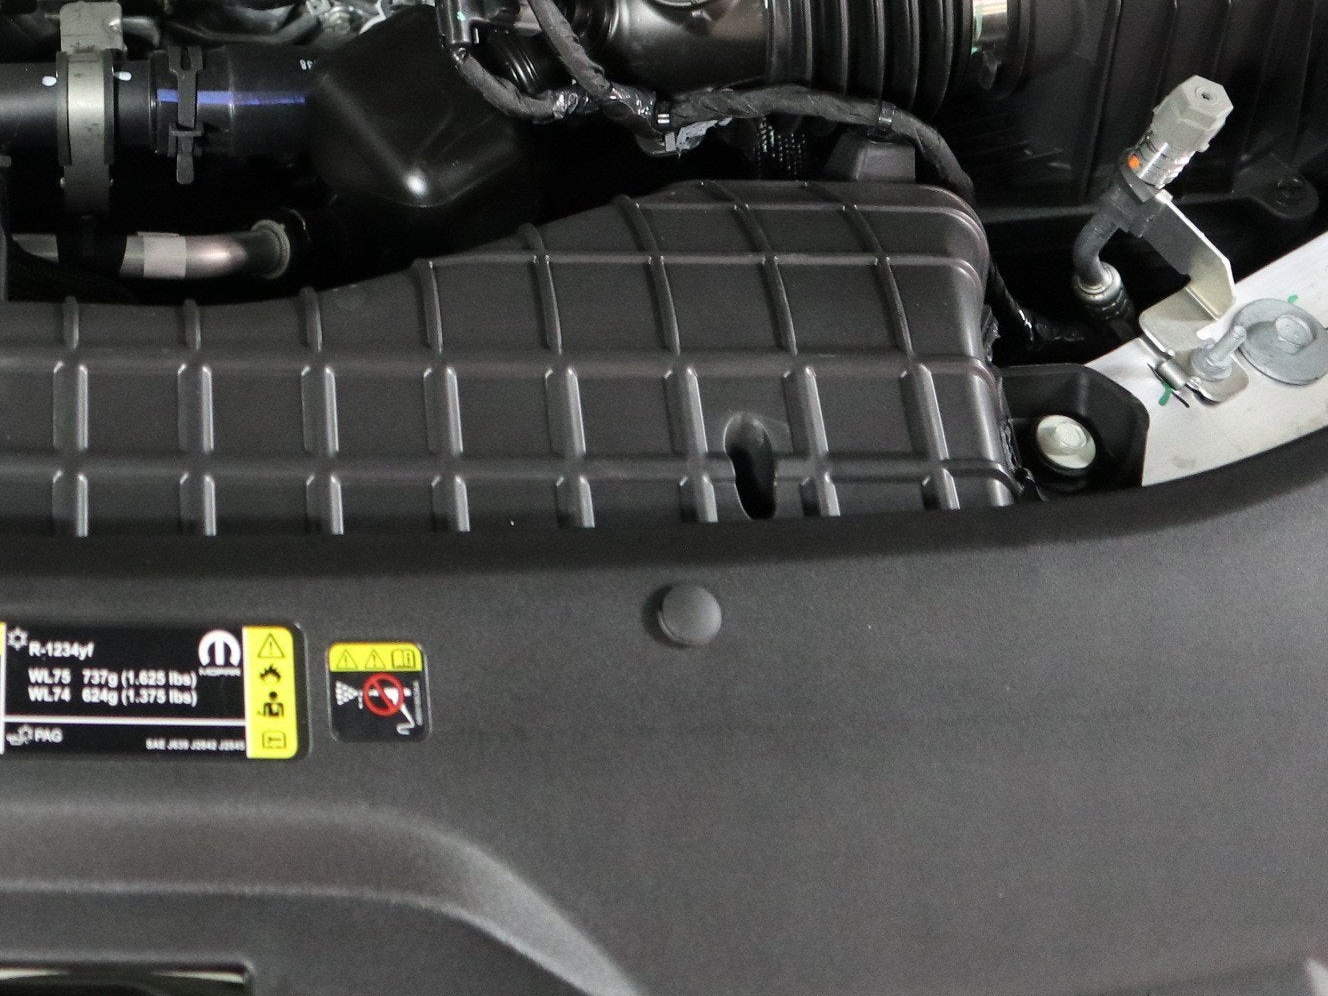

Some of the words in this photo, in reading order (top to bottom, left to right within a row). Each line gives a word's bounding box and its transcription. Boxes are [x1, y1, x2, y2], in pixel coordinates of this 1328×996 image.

[28, 641, 94, 661] R-1234yf
[28, 667, 71, 684] WL75
[82, 668, 118, 688] 737g
[121, 669, 165, 687] (1.625
[169, 669, 197, 688] lbs)
[28, 686, 71, 702] WL74
[82, 687, 118, 706] 624g
[121, 687, 166, 706] (1.375
[169, 688, 197, 707] lbs)
[34, 727, 63, 743] PAG
[146, 737, 166, 750] SAE
